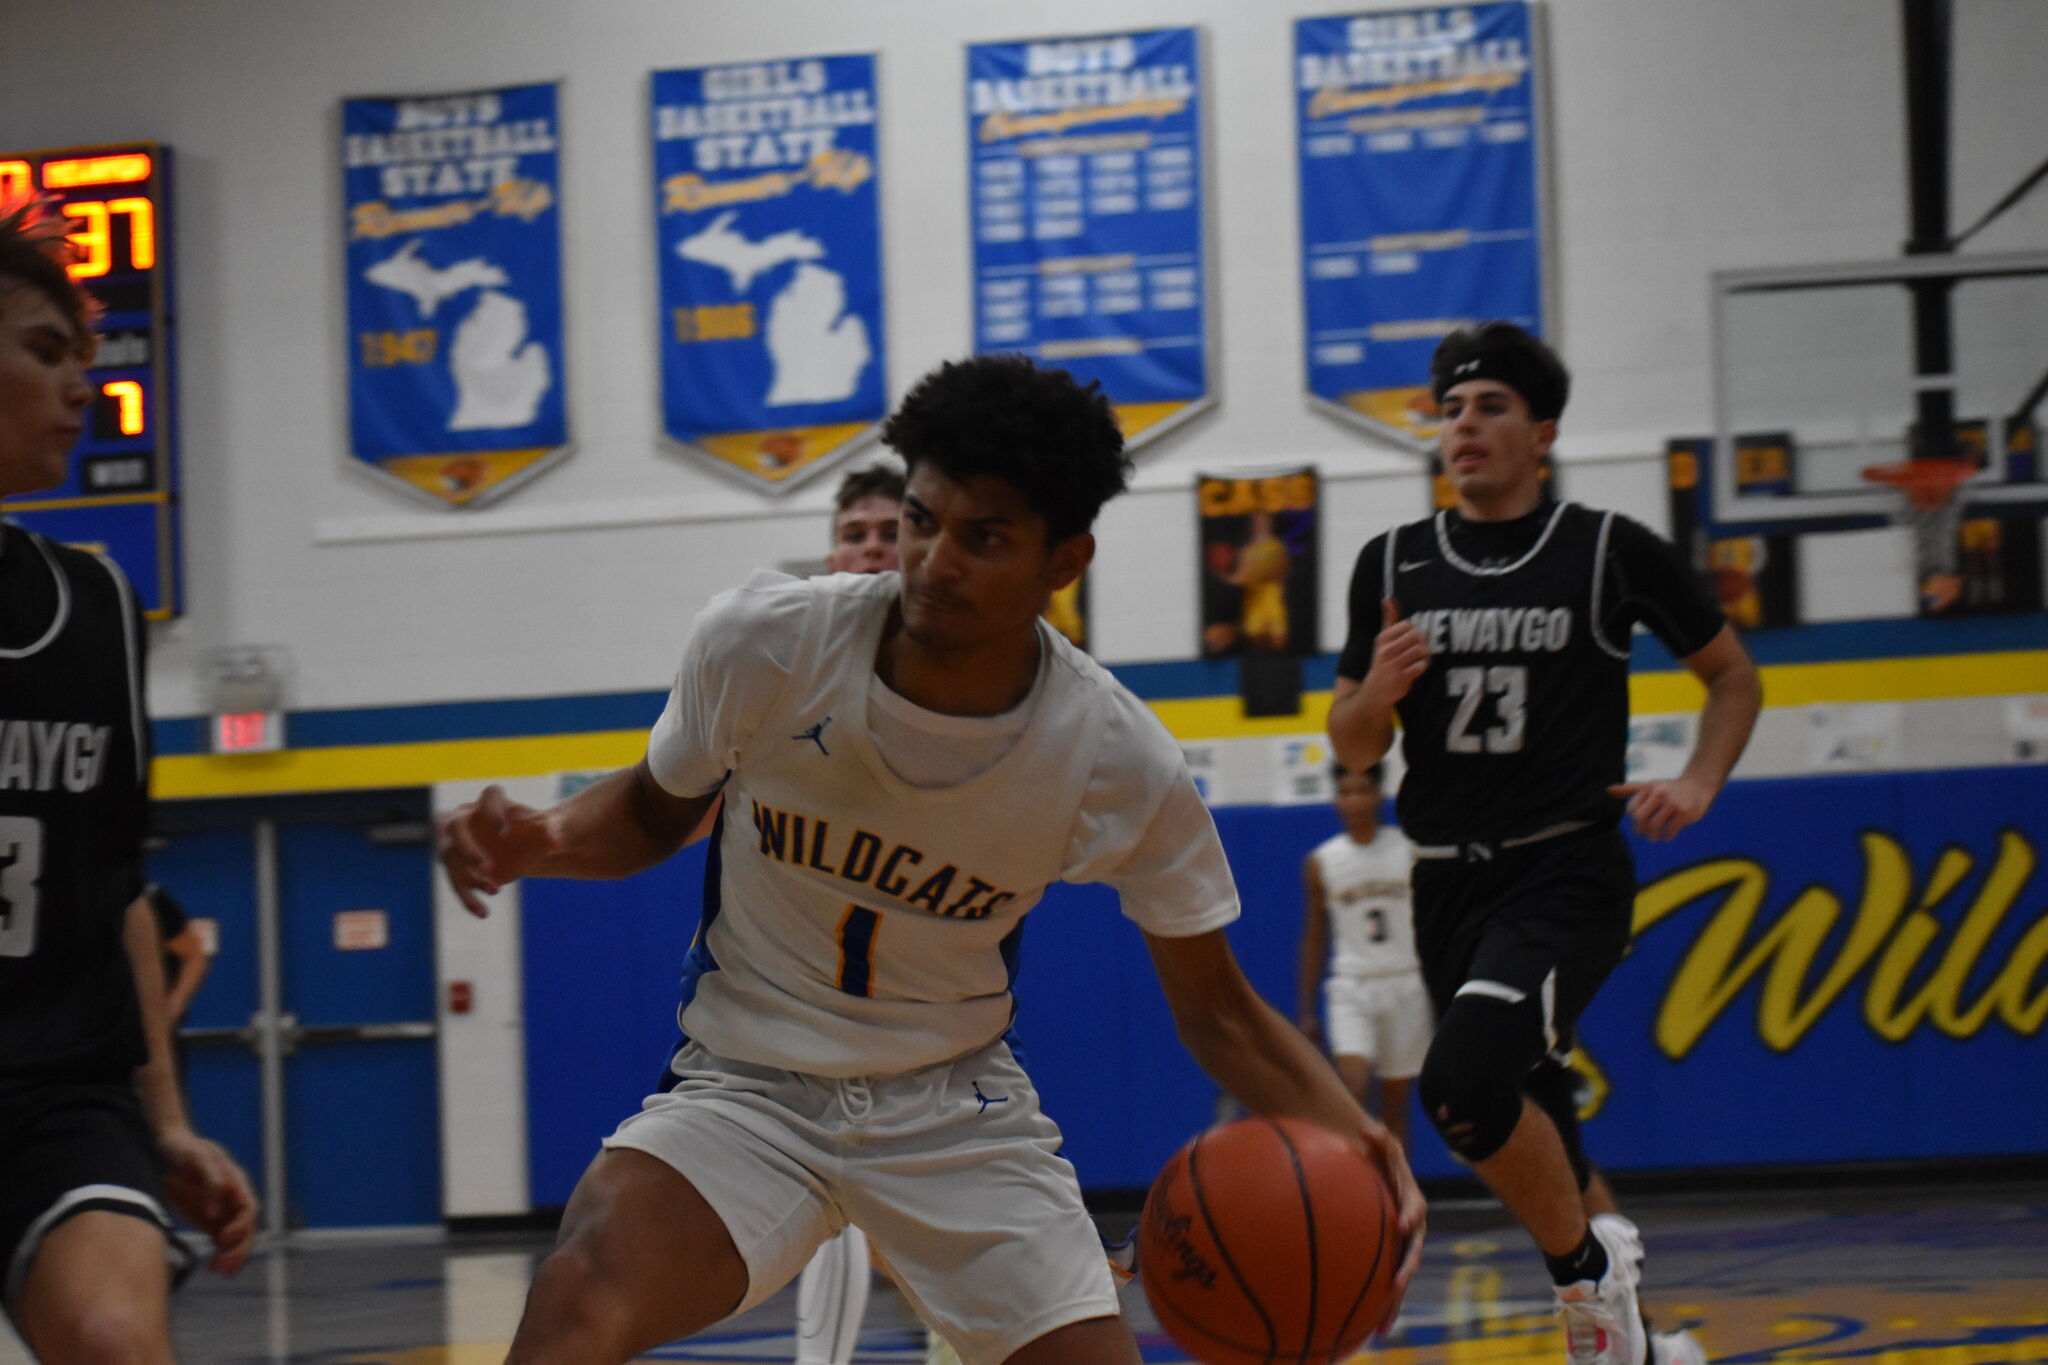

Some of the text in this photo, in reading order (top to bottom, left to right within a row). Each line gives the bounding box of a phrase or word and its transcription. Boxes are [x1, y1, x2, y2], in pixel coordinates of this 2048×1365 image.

[703, 60, 826, 102] GIRLS
[656, 88, 873, 140] BASKETBALL
[380, 154, 520, 200] STATE
[695, 127, 838, 172] STATE
[62, 197, 154, 278] 37
[102, 380, 144, 435] 7
[1446, 664, 1528, 754] 23
[752, 798, 1016, 921] WILDCATS
[835, 902, 884, 999] 1
